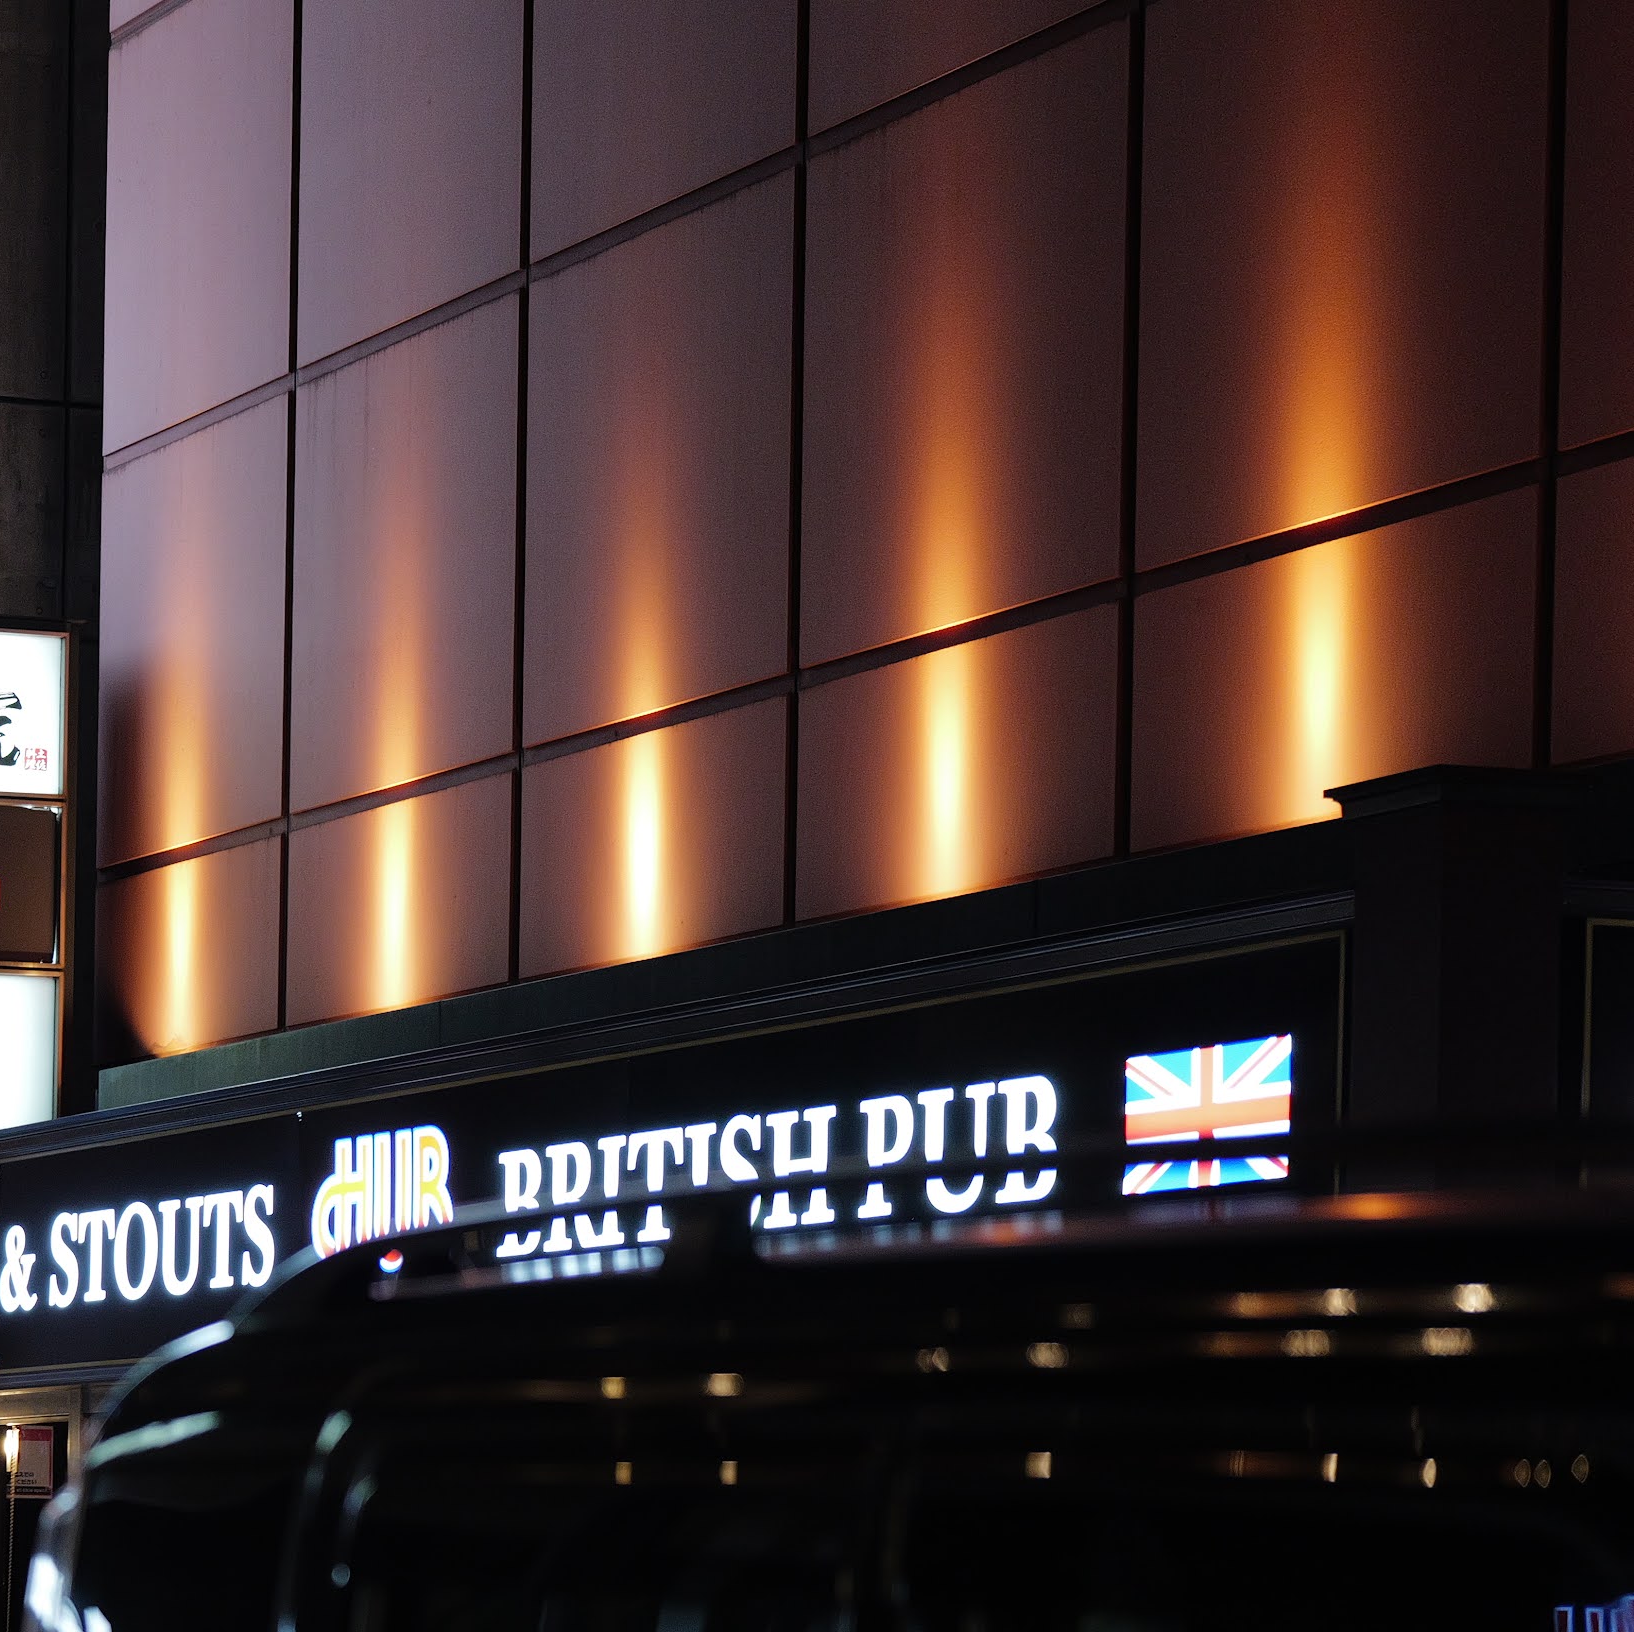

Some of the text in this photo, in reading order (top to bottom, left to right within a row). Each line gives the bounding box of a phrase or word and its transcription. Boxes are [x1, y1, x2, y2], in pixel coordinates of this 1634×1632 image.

[497, 1104, 837, 1259] BRITISH
[860, 1074, 1058, 1218] PUB
[0, 1225, 37, 1314] &
[49, 1183, 276, 1308] STOUTS
